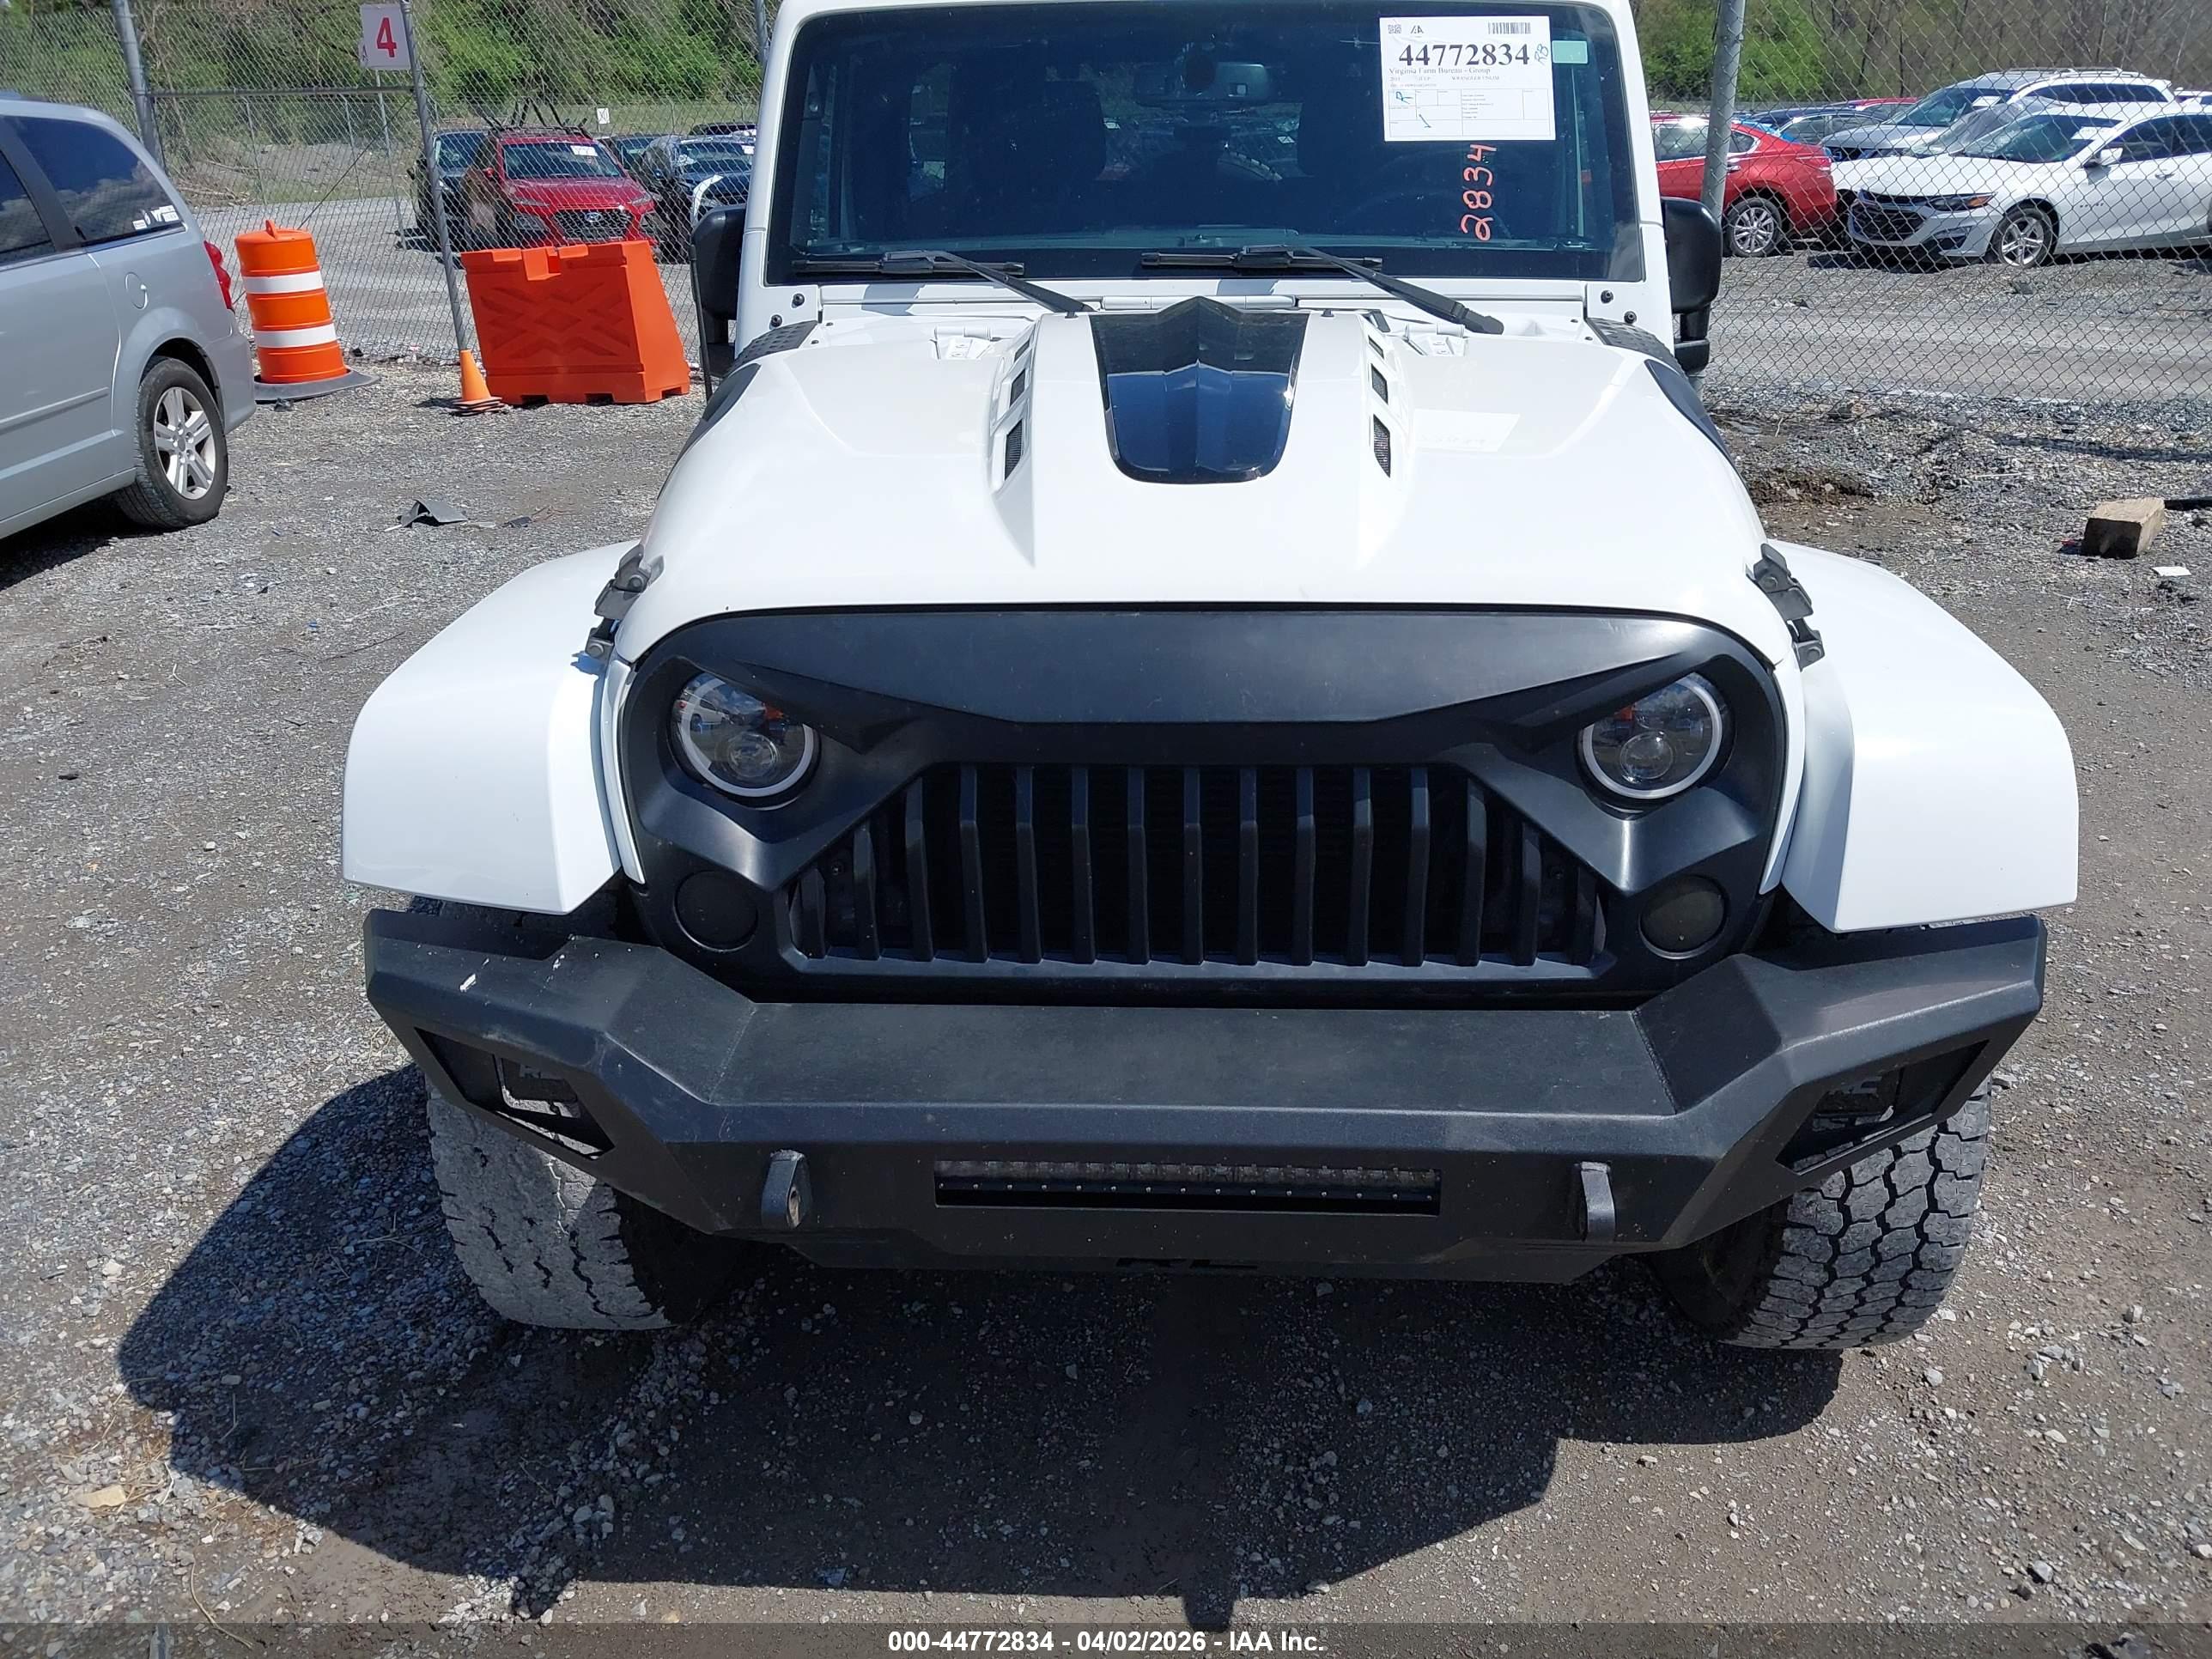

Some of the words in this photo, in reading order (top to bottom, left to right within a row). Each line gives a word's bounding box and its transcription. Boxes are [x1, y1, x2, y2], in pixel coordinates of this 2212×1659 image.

[376, 17, 398, 58] 4
[1399, 44, 1530, 66] 44772834
[1389, 67, 1417, 76] Virginia
[1461, 143, 1498, 241] 2834
